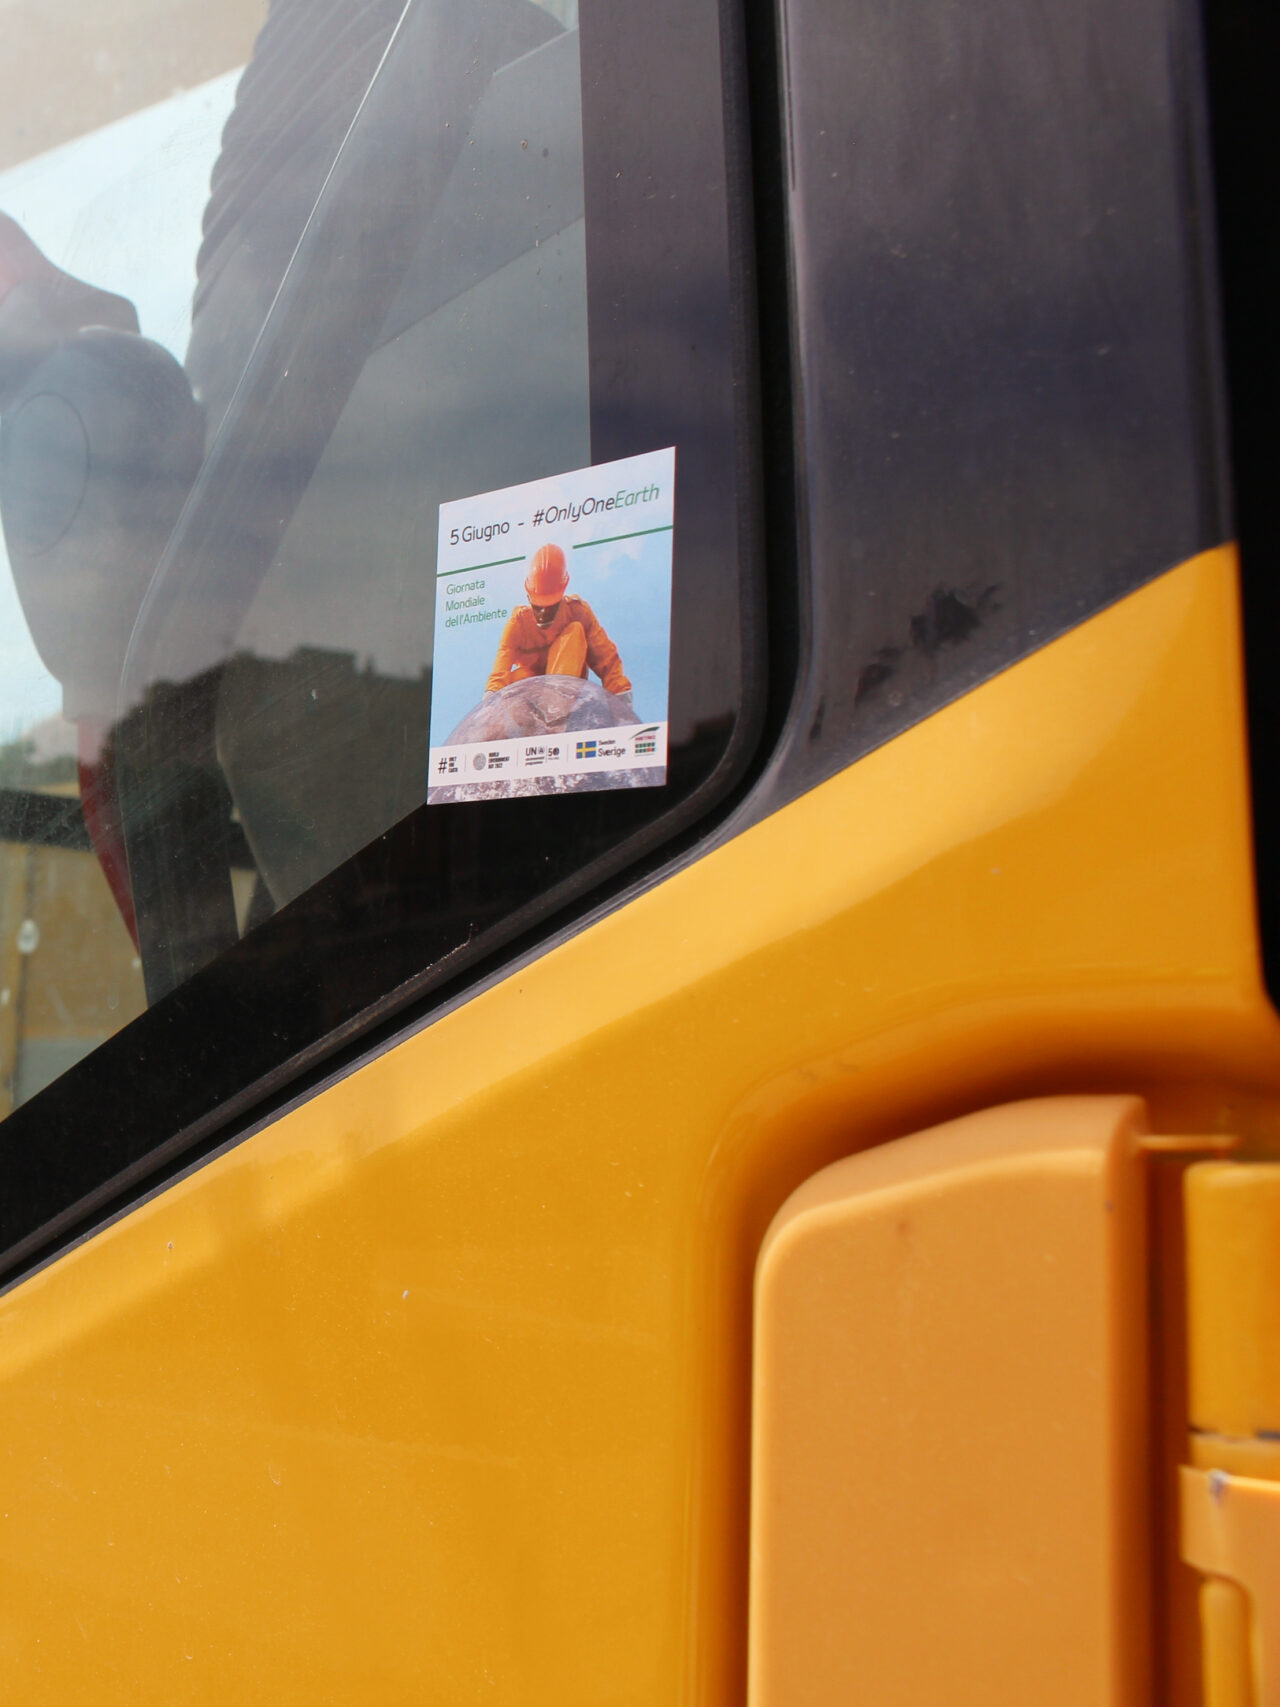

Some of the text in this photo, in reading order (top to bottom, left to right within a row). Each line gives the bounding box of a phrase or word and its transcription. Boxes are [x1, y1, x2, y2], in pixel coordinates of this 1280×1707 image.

[450, 528, 460, 545] 5
[462, 521, 510, 542] Giugno
[532, 483, 660, 527] #OnlyOneEarth
[446, 578, 486, 595] Giornata
[445, 595, 486, 611] Mondiale
[445, 608, 508, 628] dell'Ambiente
